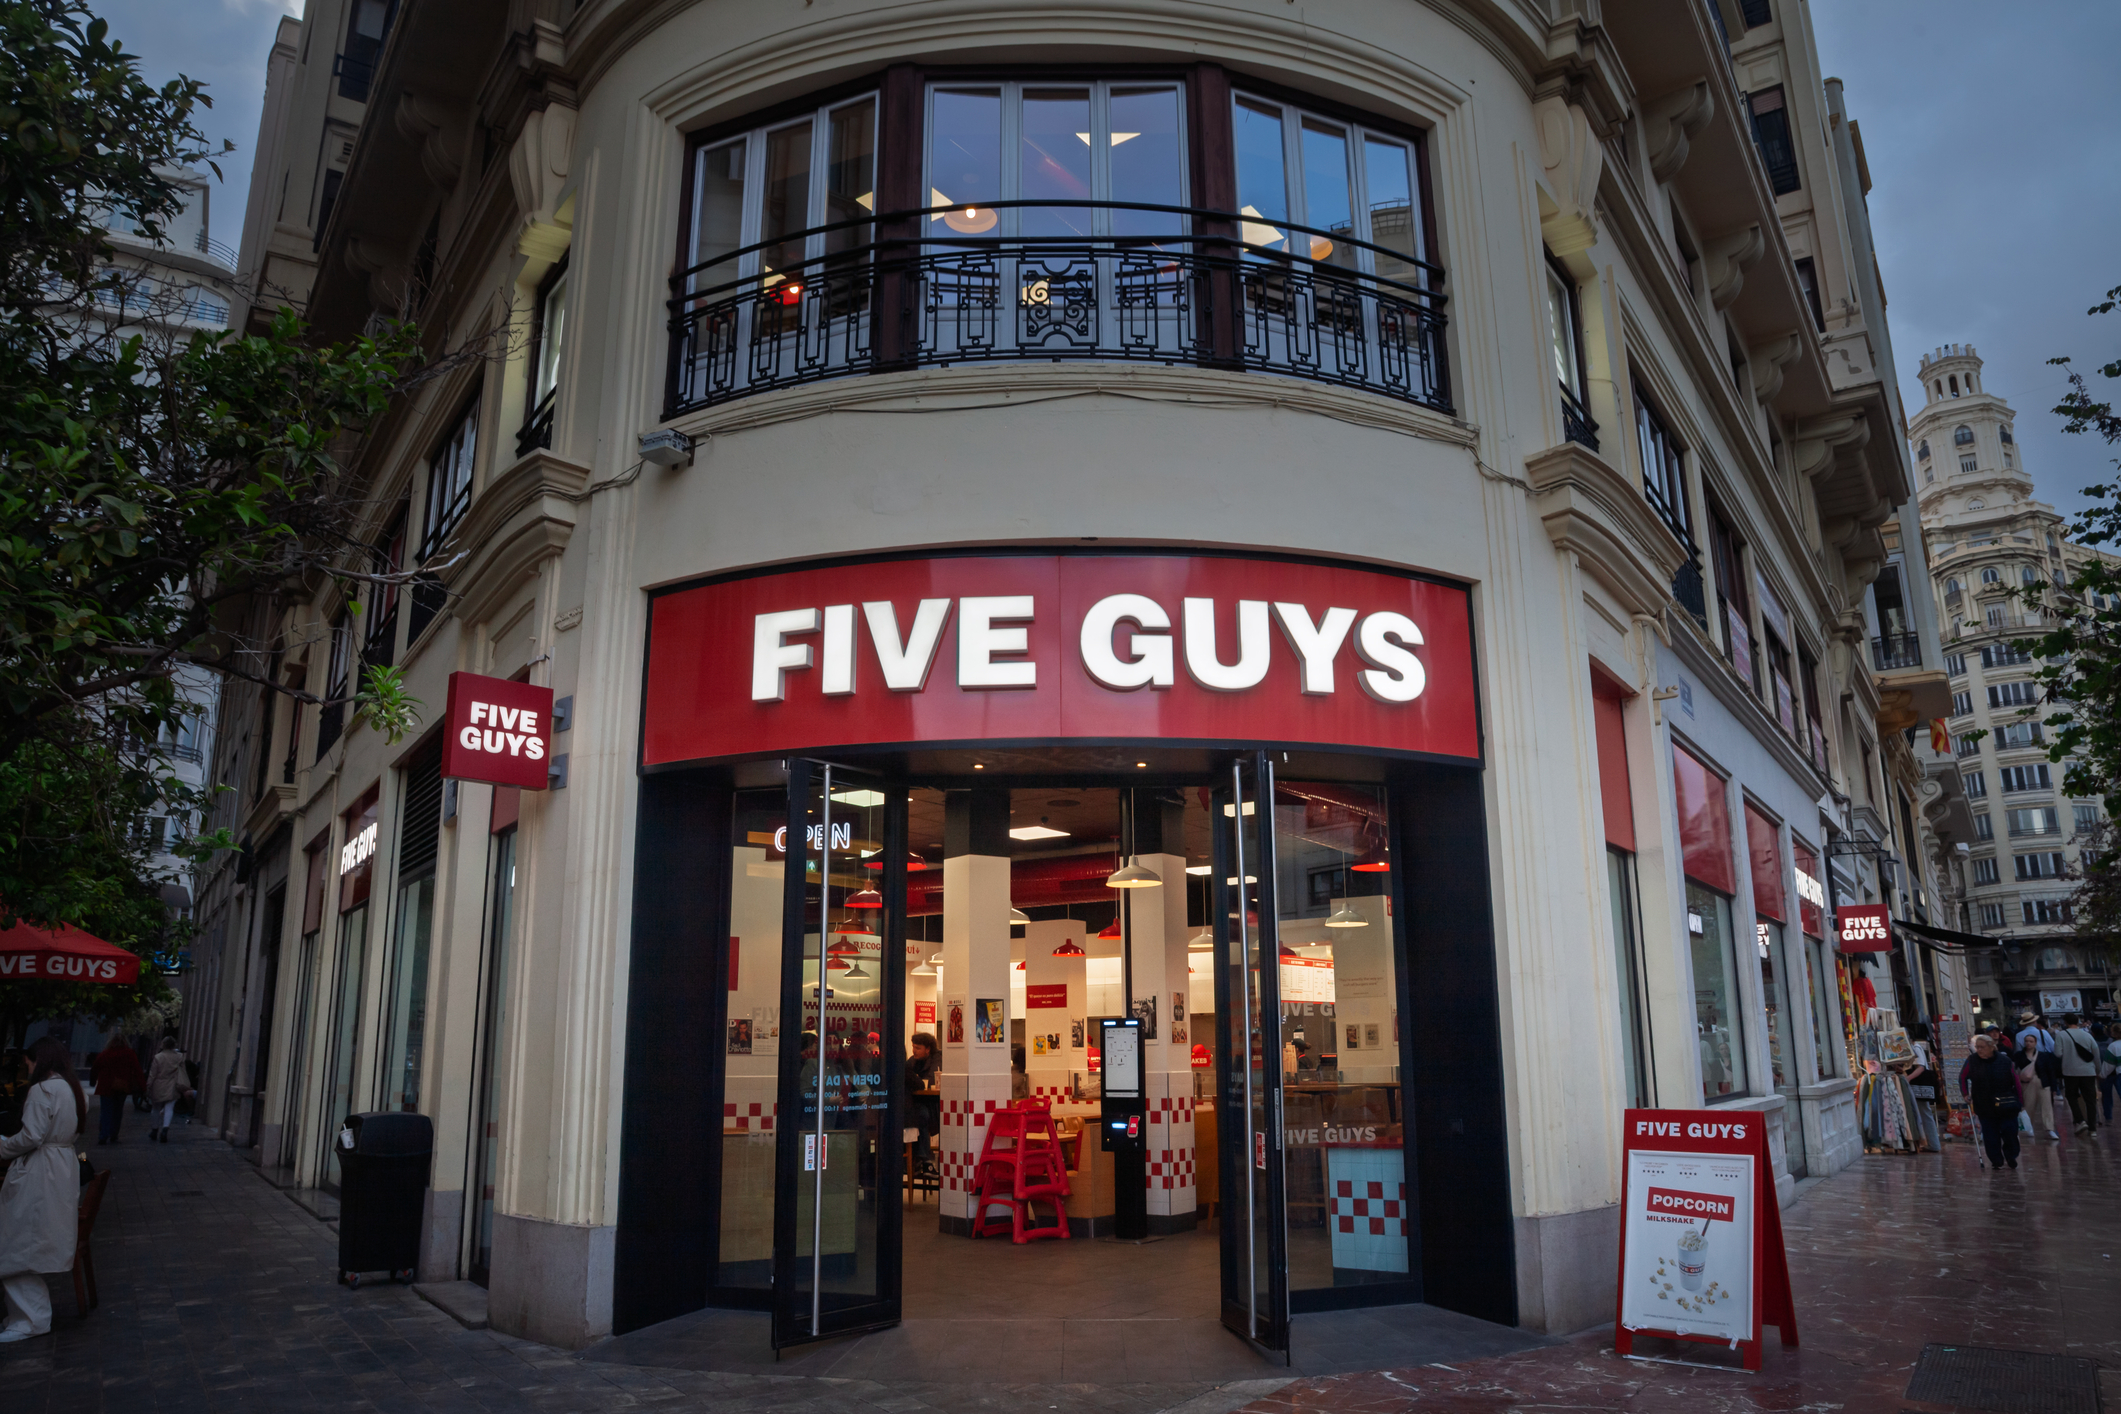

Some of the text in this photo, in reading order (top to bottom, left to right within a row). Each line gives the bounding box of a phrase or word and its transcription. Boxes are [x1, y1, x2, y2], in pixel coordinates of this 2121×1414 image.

[751, 593, 1427, 703] FIVE GUYS
[470, 701, 538, 734] FIVE
[459, 726, 544, 760] GUYS
[1844, 916, 1882, 929] FIVE
[1842, 927, 1888, 941] GUYS
[46, 955, 117, 979] GUYS
[1325, 1126, 1377, 1143] GUYS
[1636, 1121, 1747, 1139] FIVE GUYS
[1652, 1194, 1729, 1215] POPCORN
[1646, 1215, 1695, 1225] MILKSHAKE
